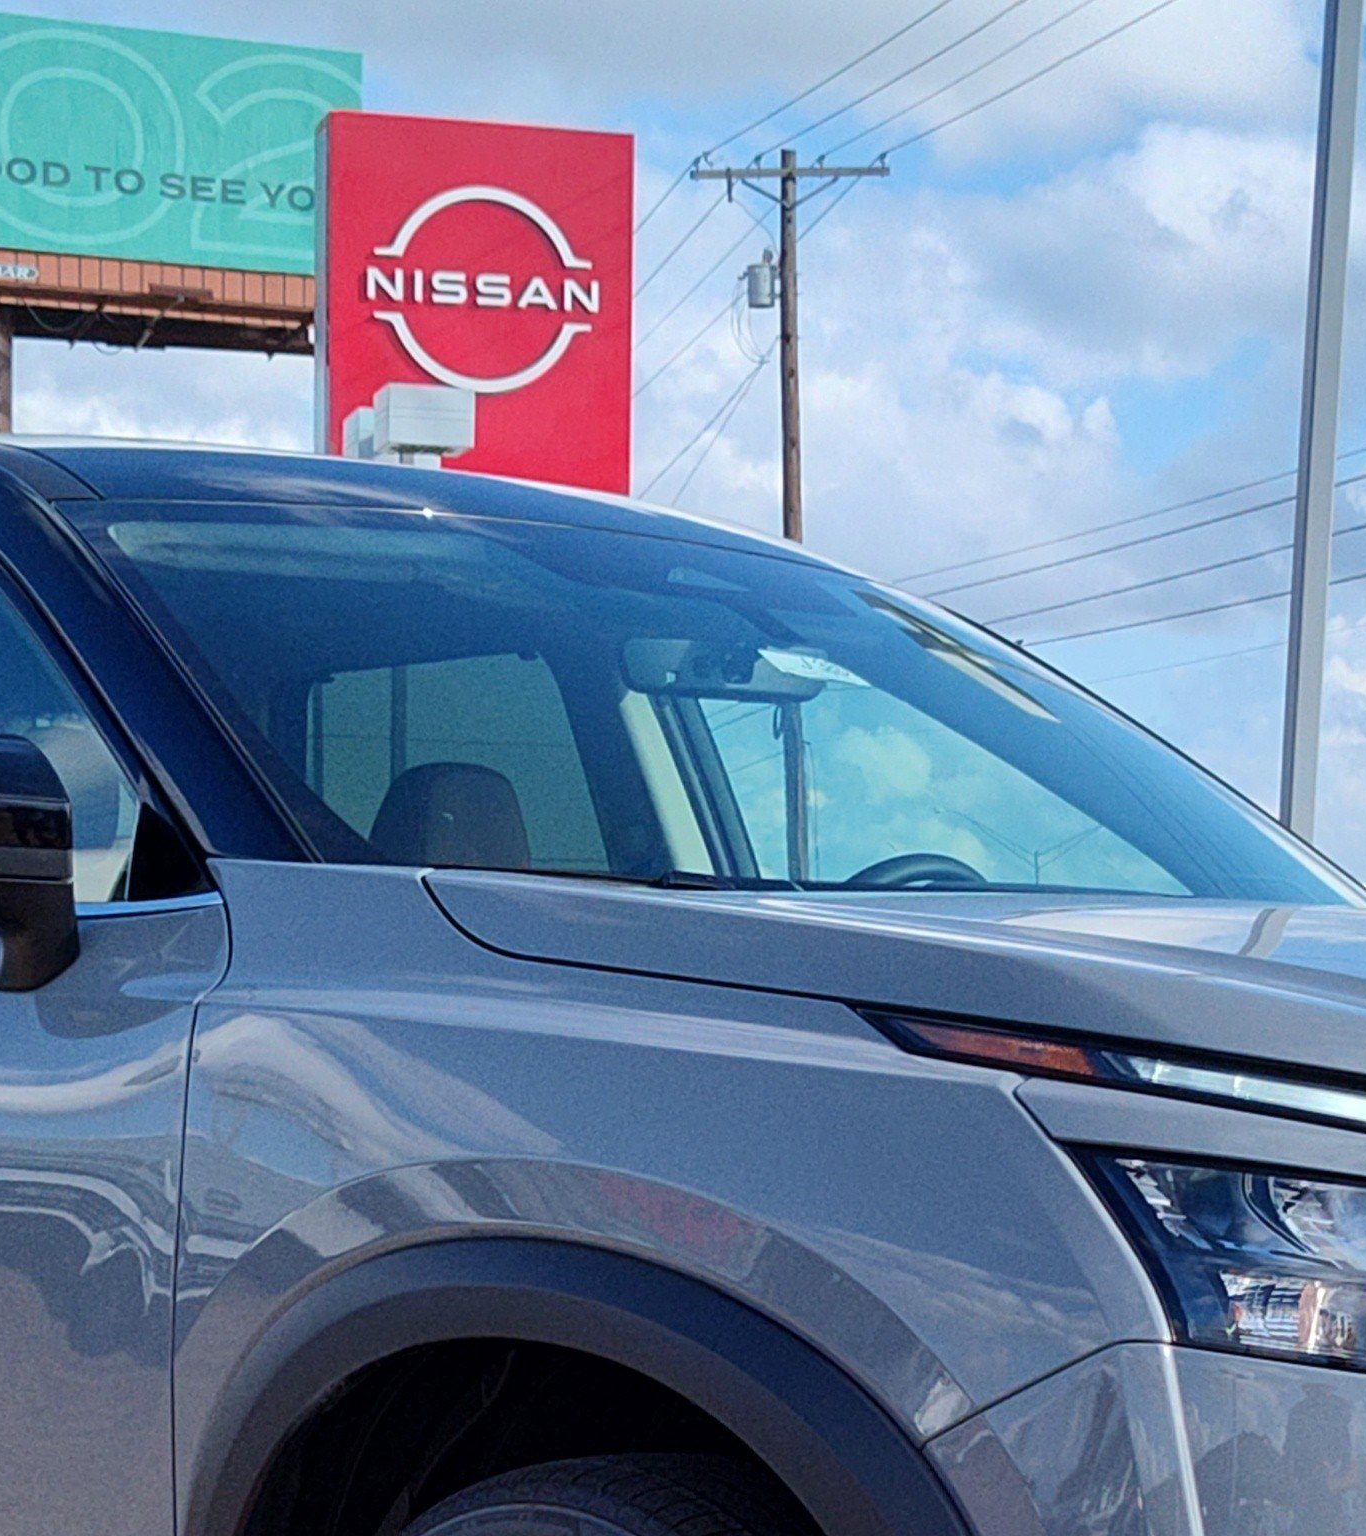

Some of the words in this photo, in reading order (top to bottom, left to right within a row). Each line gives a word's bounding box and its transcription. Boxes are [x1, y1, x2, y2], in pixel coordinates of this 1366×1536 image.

[84, 163, 145, 197] TO
[158, 172, 247, 206] SEE
[257, 180, 315, 212] YO
[365, 264, 600, 314] NISSAN
